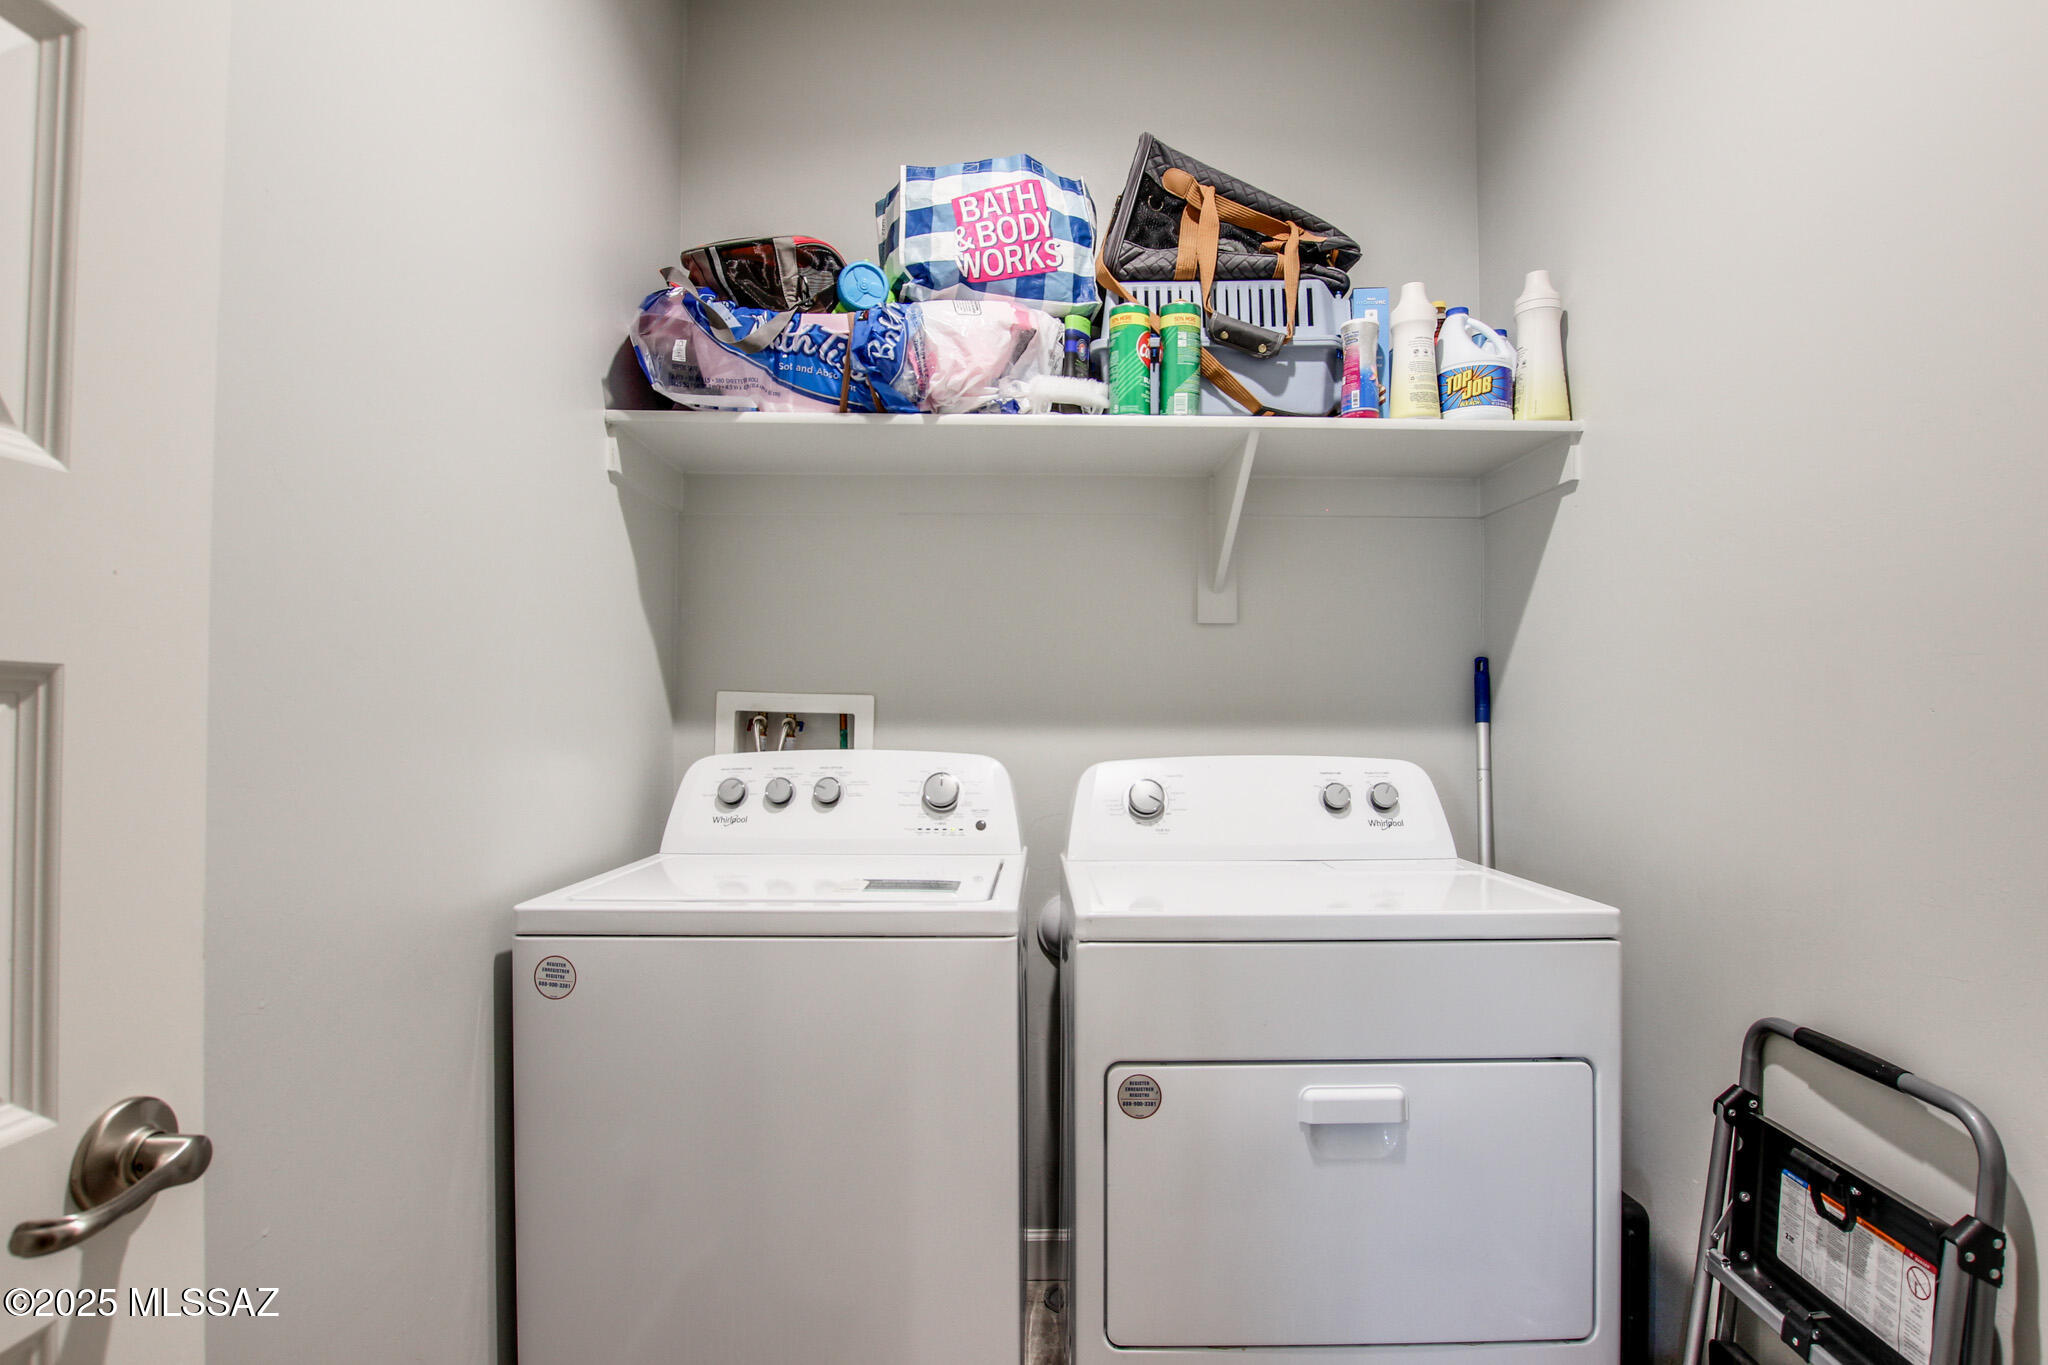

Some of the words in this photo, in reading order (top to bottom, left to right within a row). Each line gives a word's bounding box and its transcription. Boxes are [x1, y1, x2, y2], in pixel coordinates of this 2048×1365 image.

[958, 182, 1039, 224] BATH
[953, 226, 975, 252] &
[975, 210, 1052, 249] BODY
[955, 238, 1064, 279] WORKS
[795, 364, 813, 374] and
[1446, 369, 1473, 395] TOP
[1462, 376, 1493, 400] JOB
[713, 815, 748, 827] Whirlpool
[1368, 818, 1404, 831] Whirlpool
